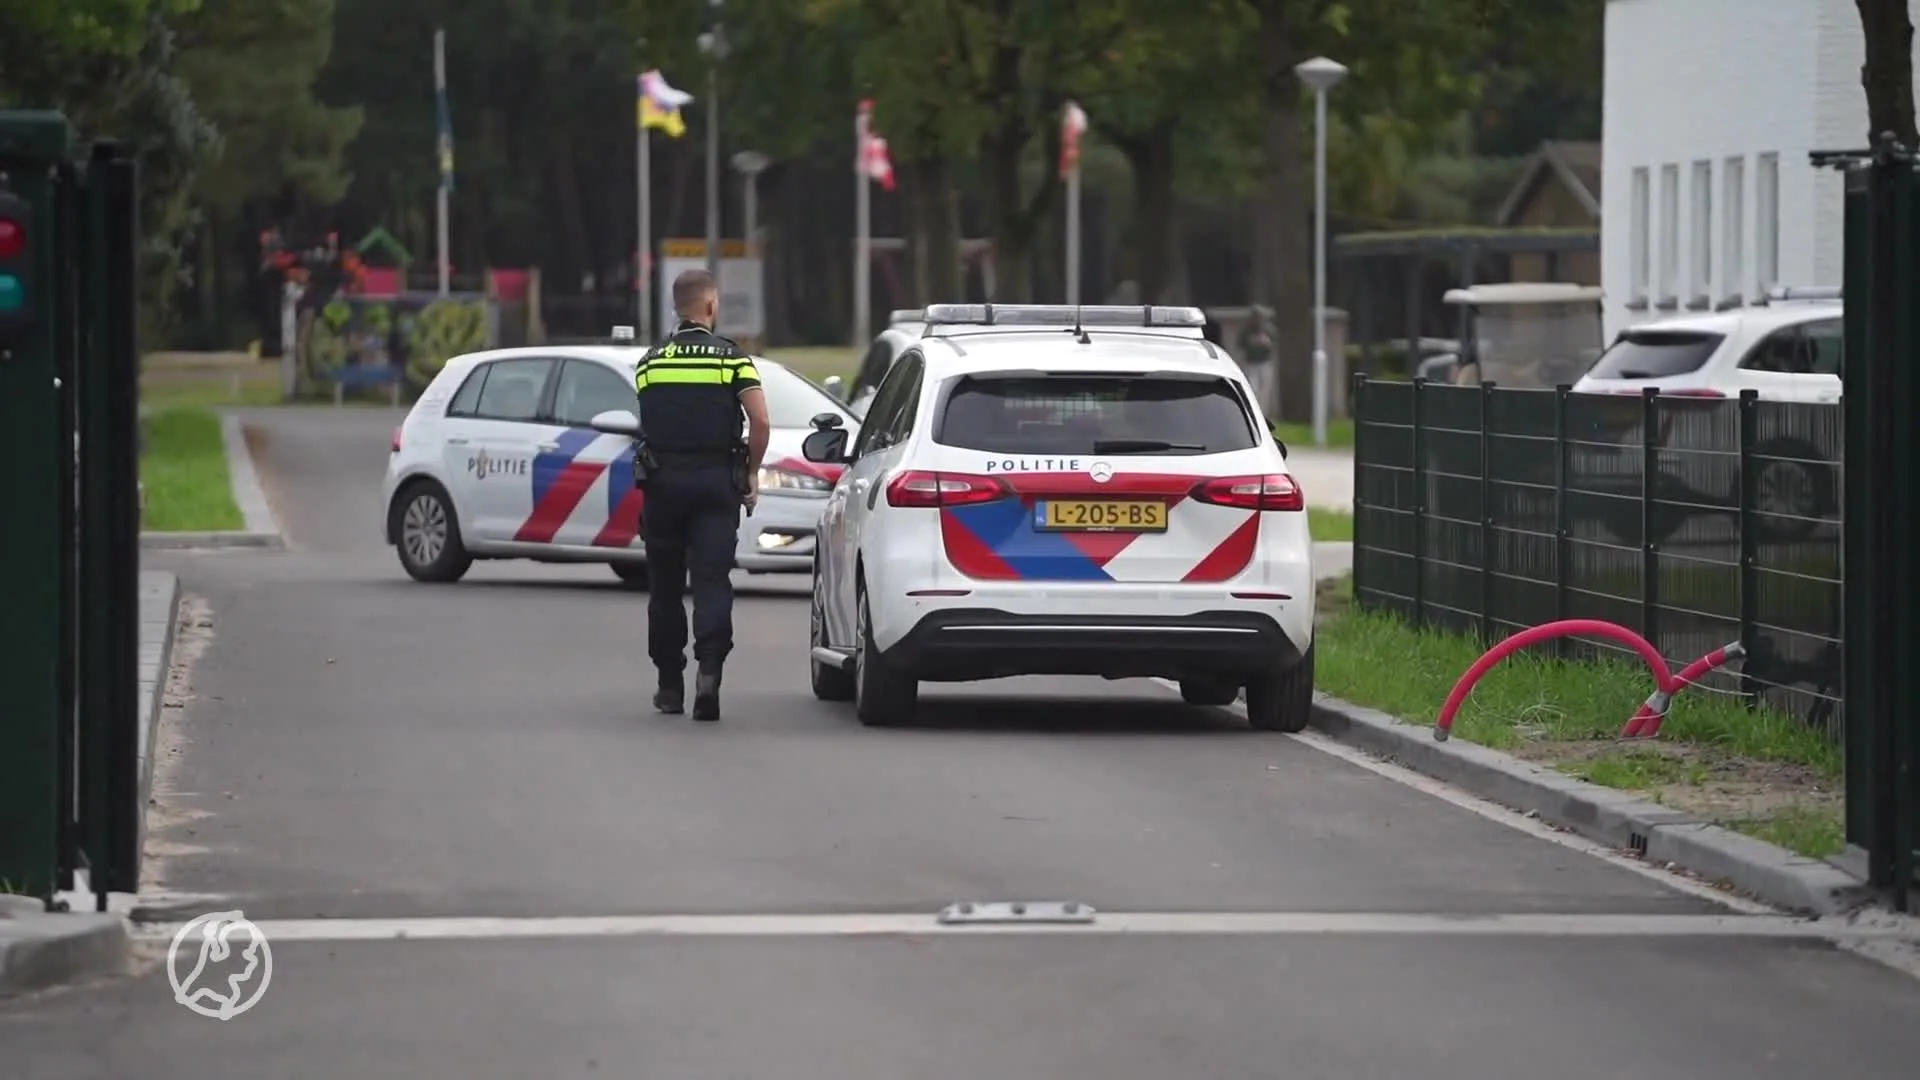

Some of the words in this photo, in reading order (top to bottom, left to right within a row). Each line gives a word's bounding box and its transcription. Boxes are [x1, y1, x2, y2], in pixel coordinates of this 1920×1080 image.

[467, 451, 526, 480] POLITIE
[986, 459, 1080, 472] POLITIE
[1054, 503, 1158, 524] L-205-BS
